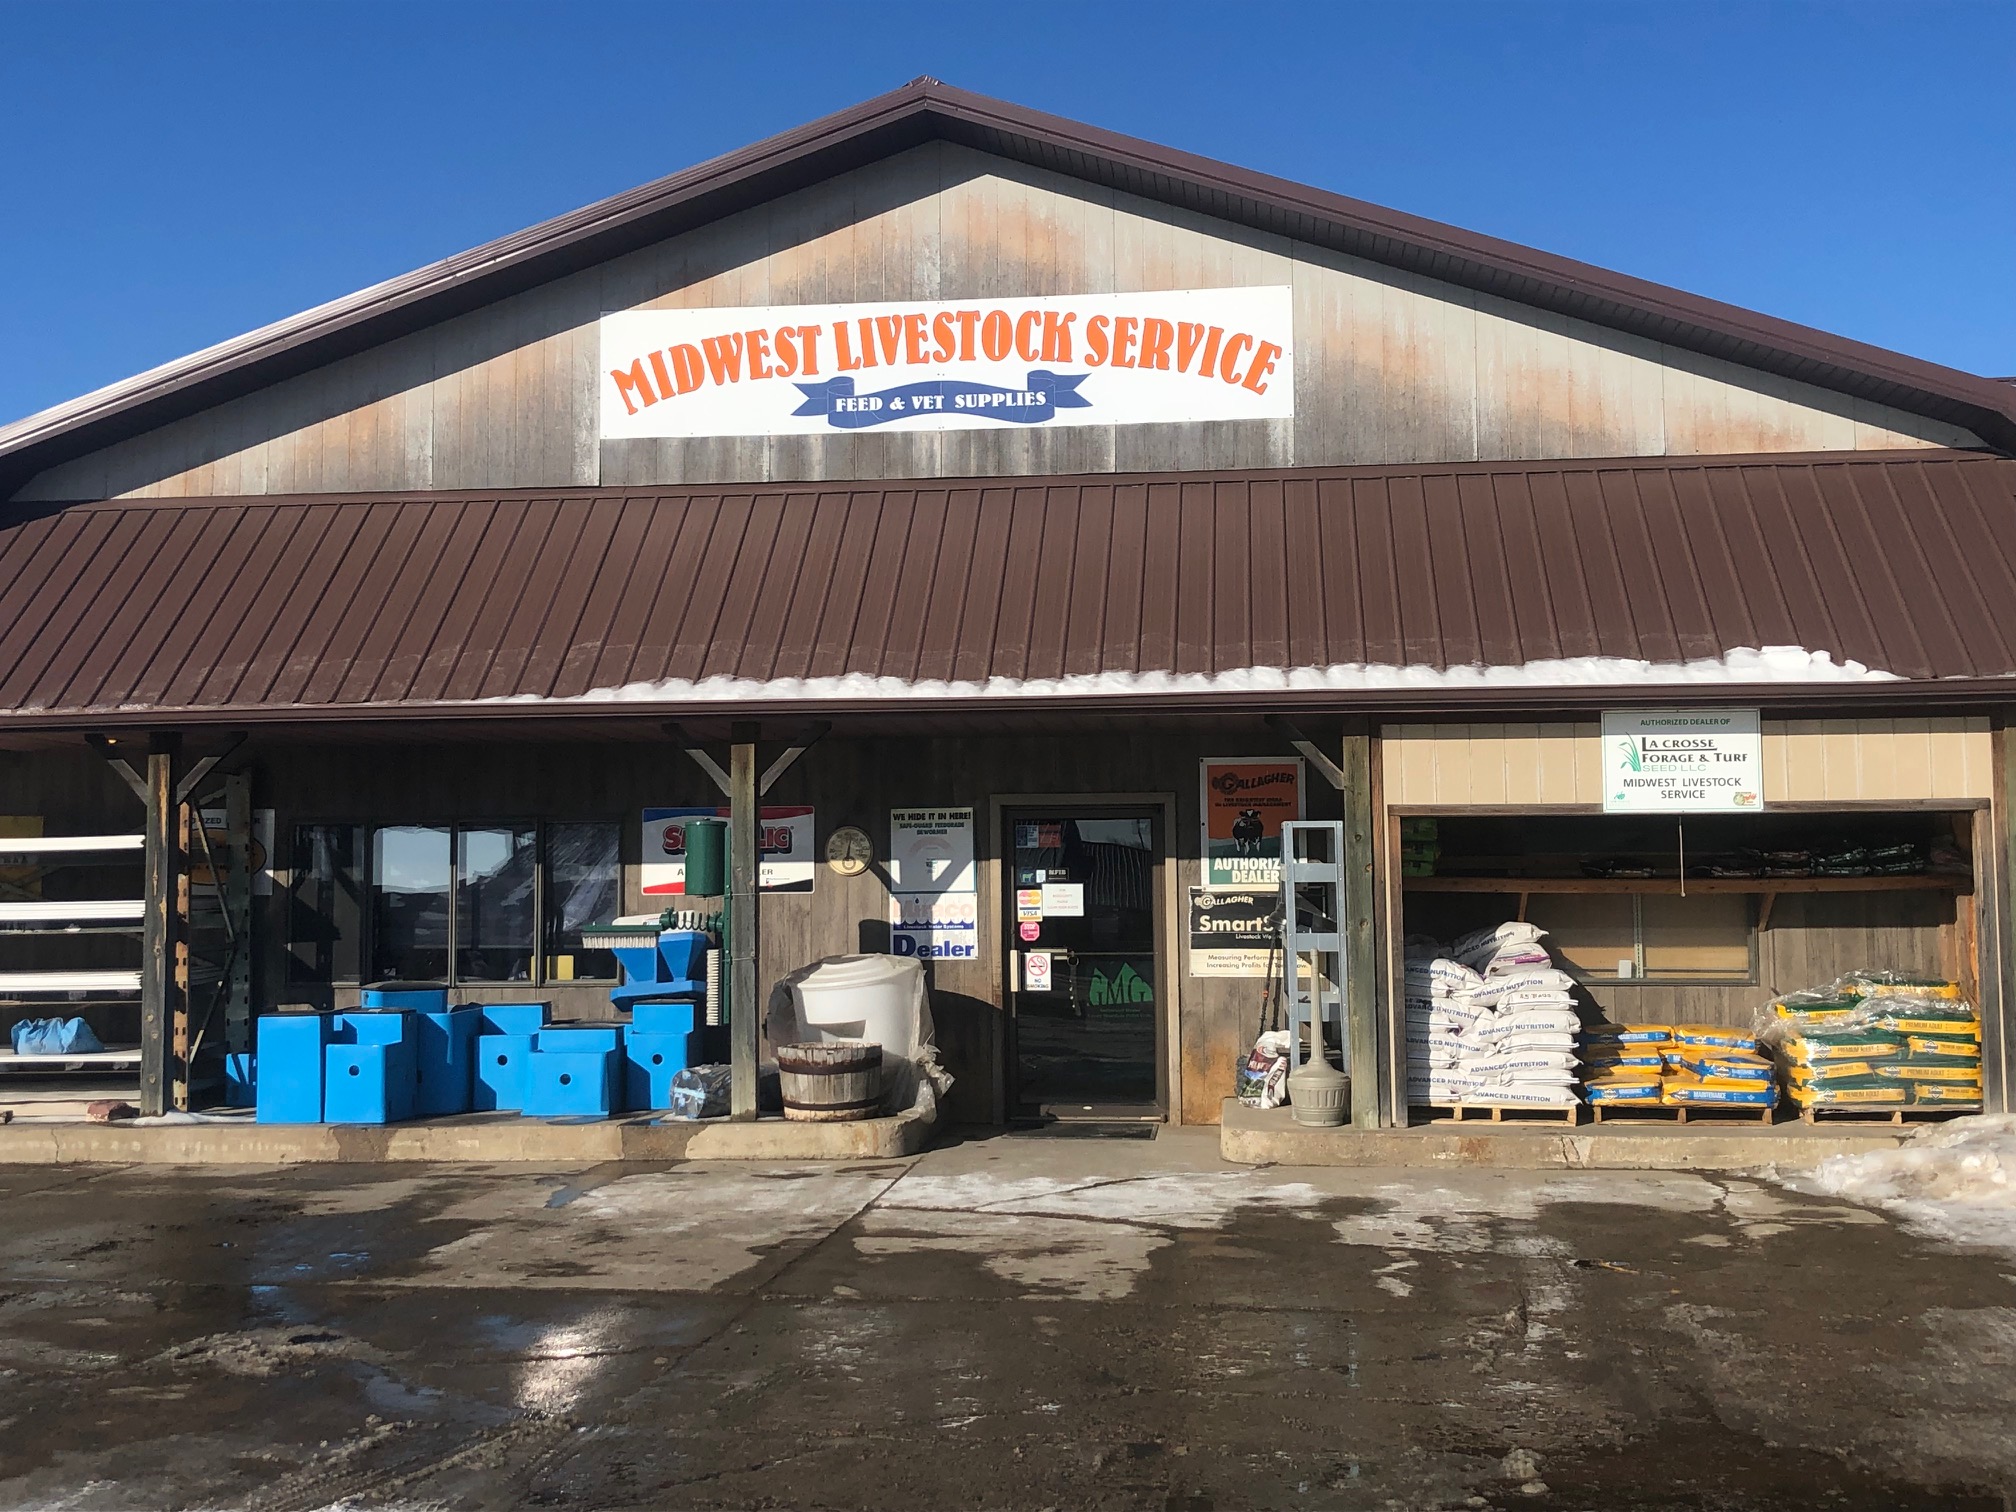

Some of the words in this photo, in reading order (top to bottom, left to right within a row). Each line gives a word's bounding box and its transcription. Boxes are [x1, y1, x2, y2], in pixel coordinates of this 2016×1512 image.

[610, 325, 822, 415] MIDWEST
[833, 310, 1077, 371] LIVESTOCK
[1084, 315, 1282, 395] SERVICE
[835, 396, 883, 412] FEED
[889, 397, 906, 410] &
[912, 395, 944, 410] VET
[954, 391, 1047, 409] SUPPLIES
[1640, 718, 1689, 726] AUTHORIZED
[1690, 718, 1719, 726] DEALER
[1642, 737, 1659, 751] LA
[1662, 739, 1715, 748] CROSSE
[1642, 753, 1695, 763] FORAGE
[1699, 753, 1710, 763] &
[1714, 752, 1748, 763] TURF
[1681, 764, 1707, 772] LLC
[1221, 772, 1295, 791] GALLAGHER
[1623, 778, 1677, 787] MIDWEST
[1682, 777, 1742, 787] LIVESTOCK
[1661, 790, 1706, 799] SERVICE
[893, 813, 906, 821] WE
[908, 812, 926, 821] HIDE
[929, 812, 936, 820] IT
[938, 812, 947, 820] IN
[949, 811, 971, 820] HERE!
[1214, 857, 1296, 870] AUTHORIZ
[1232, 870, 1280, 883] DEALER
[1203, 895, 1254, 906] GALLAGHER
[893, 934, 975, 957] Dealer
[1444, 1041, 1481, 1052] NUTRITION
[1470, 1063, 1508, 1073] ADVANCED
[1510, 1093, 1551, 1102] NUTRITION
[1694, 1091, 1726, 1099] MAINTENANCE
